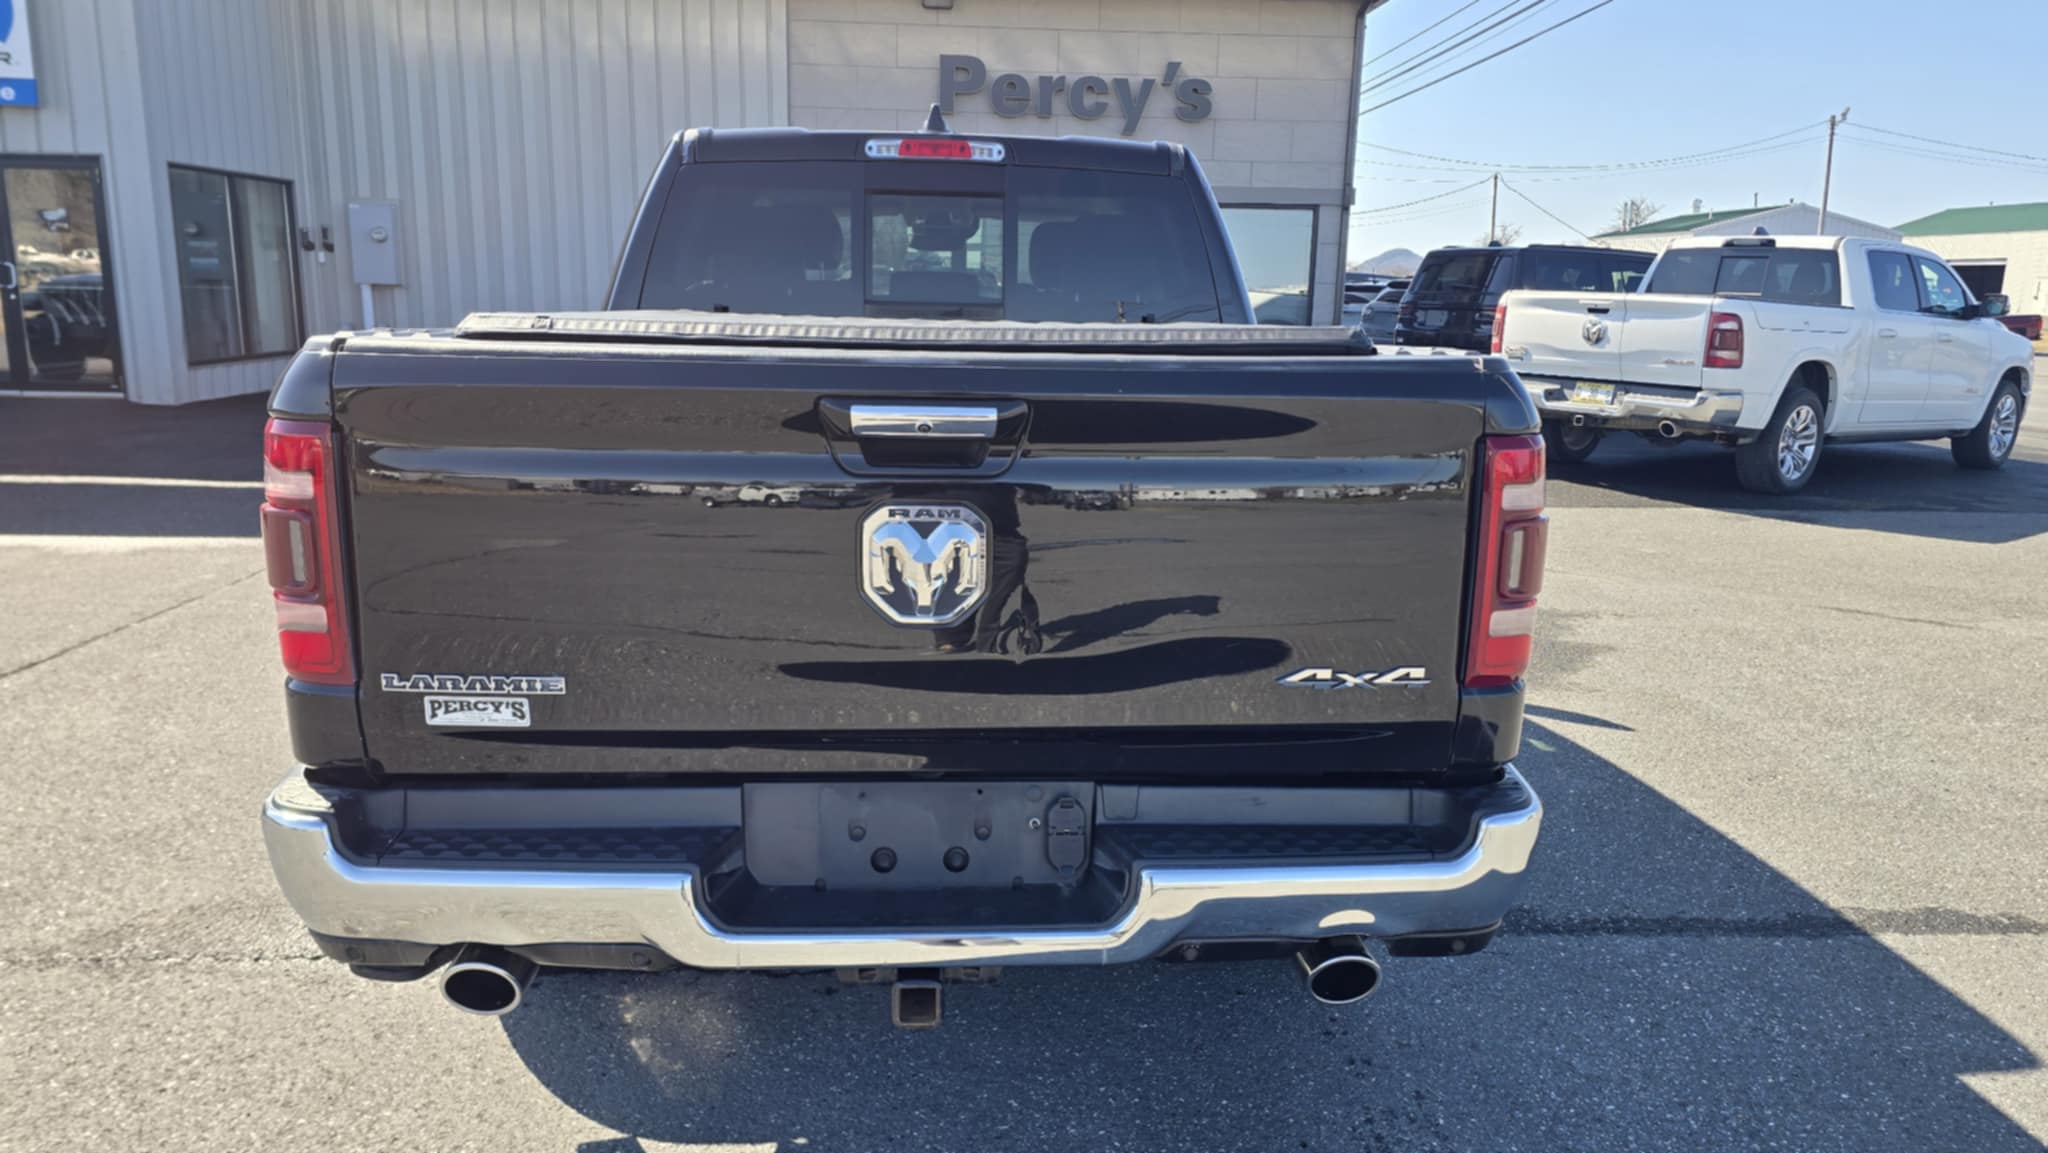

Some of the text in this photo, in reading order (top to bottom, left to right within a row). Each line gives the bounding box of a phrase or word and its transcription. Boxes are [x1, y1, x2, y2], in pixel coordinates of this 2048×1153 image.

[938, 53, 1214, 136] Percy's
[887, 508, 962, 520] RAM
[381, 672, 567, 695] LARAMIE
[429, 699, 526, 721] PERCY'S
